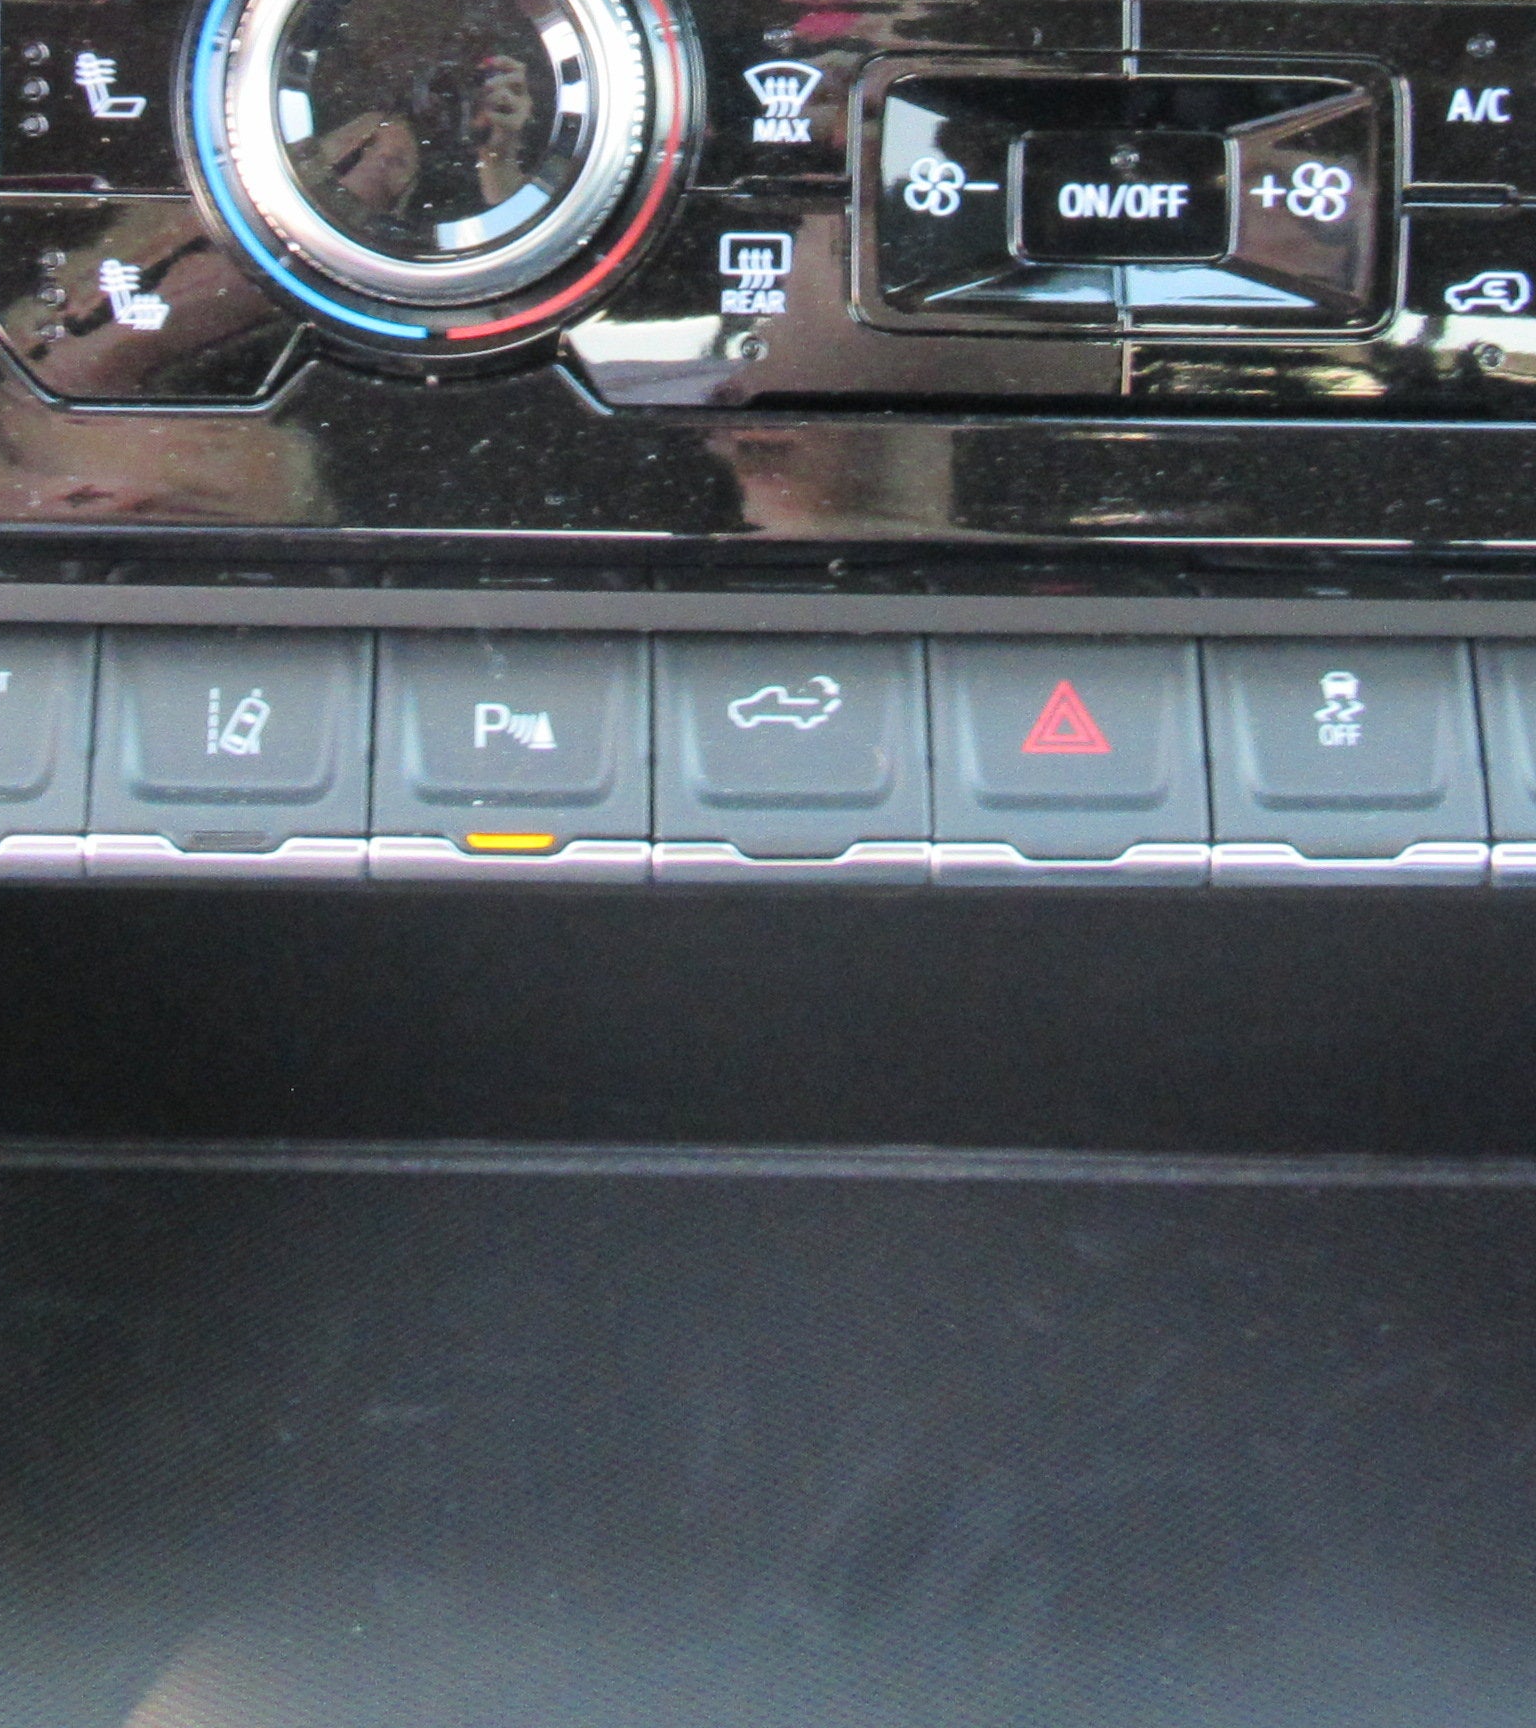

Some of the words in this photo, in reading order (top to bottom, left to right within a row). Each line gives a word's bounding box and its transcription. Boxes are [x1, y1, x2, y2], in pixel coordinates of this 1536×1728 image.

[1445, 87, 1511, 124] A/C
[752, 118, 812, 144] MAX
[1057, 182, 1189, 220] ON/OFF
[720, 288, 787, 315] REAR
[1317, 723, 1363, 747] OFF
